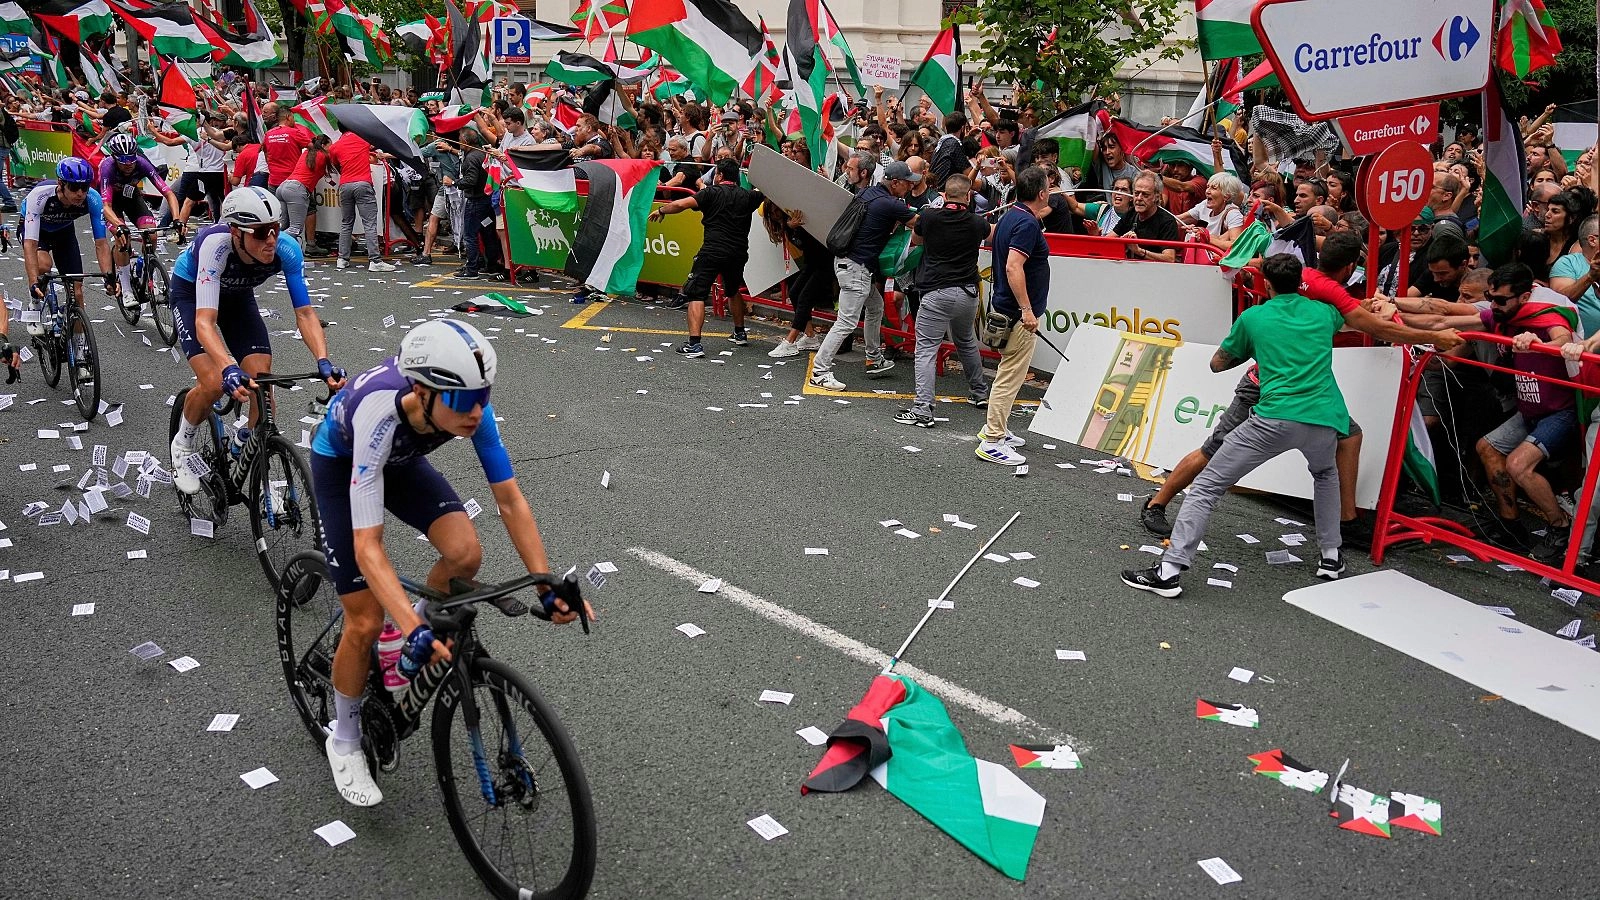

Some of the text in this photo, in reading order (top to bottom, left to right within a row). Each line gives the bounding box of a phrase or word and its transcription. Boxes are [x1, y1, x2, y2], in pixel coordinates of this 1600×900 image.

[501, 20, 522, 55] P
[1294, 32, 1422, 73] Carrefour
[874, 70, 899, 79] GENOCIDE
[1353, 123, 1406, 143] Carrefour
[1378, 168, 1425, 204] 150
[278, 559, 305, 662] BLACK INC
[340, 787, 372, 805] nimbl
